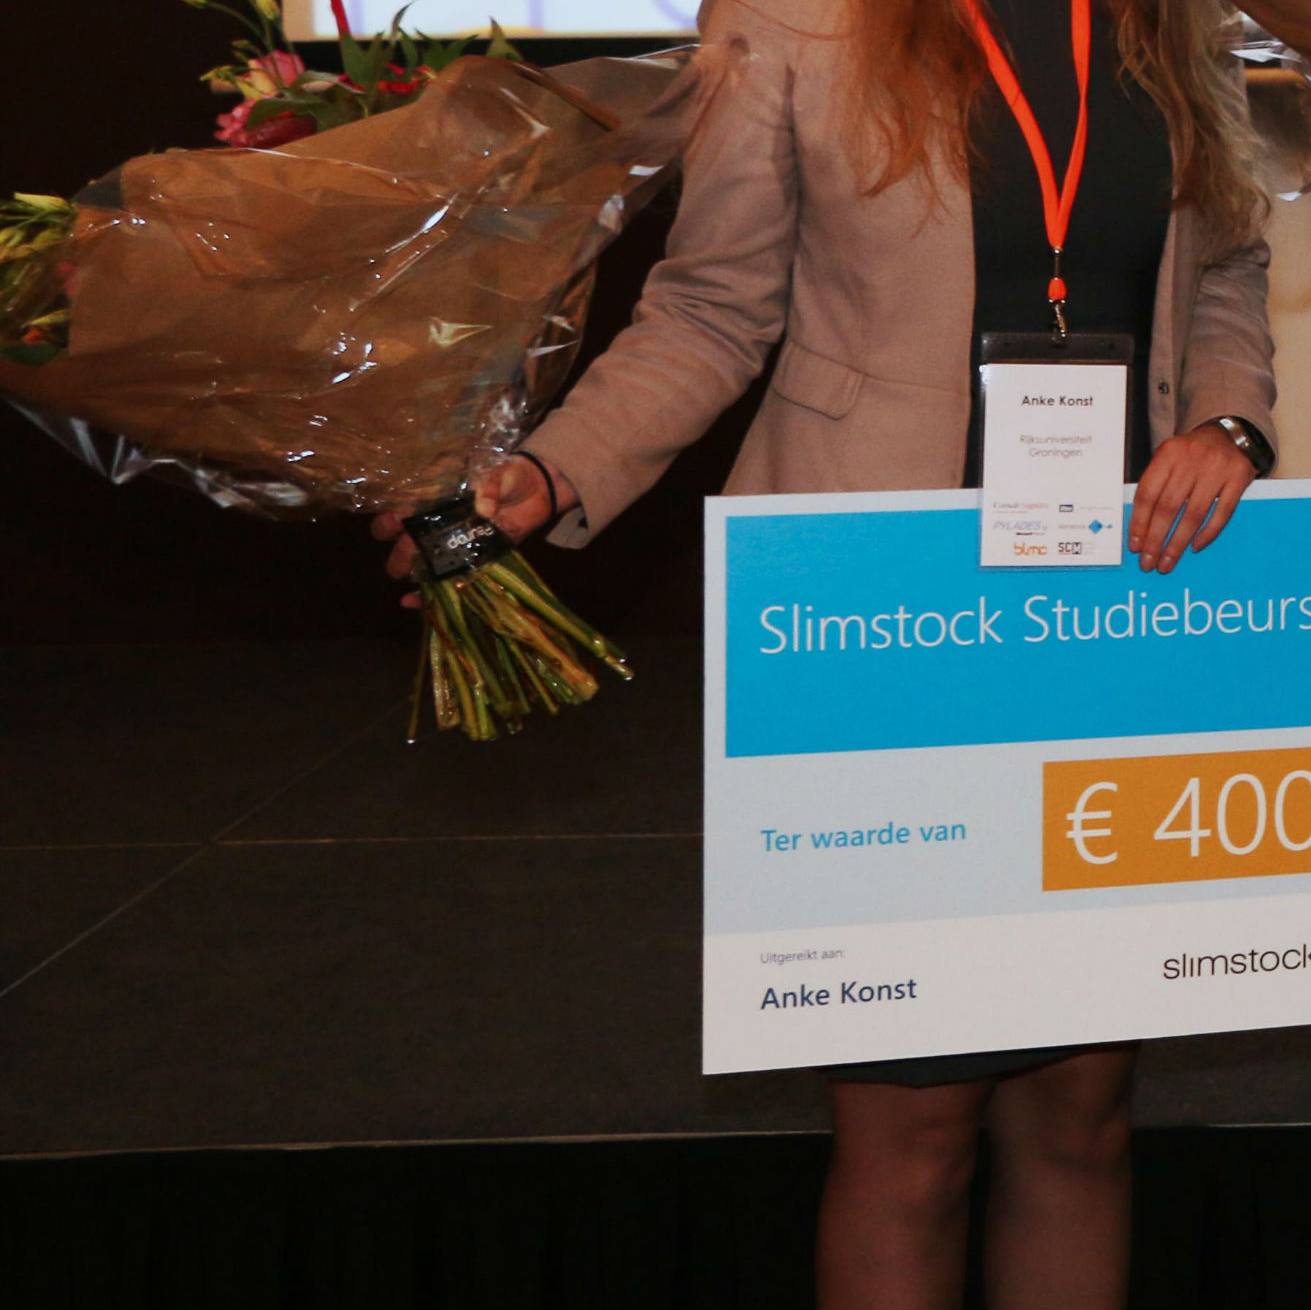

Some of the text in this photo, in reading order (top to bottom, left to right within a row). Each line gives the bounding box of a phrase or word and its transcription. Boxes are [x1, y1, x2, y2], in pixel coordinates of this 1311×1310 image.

[1020, 395, 1094, 407] Anke Konst
[759, 595, 1003, 654] Slimstock
[760, 821, 966, 852] Ter waarde van
[1065, 781, 1118, 865] €
[760, 950, 818, 966] Uitgereikt
[760, 979, 917, 1010] Anke Konst
